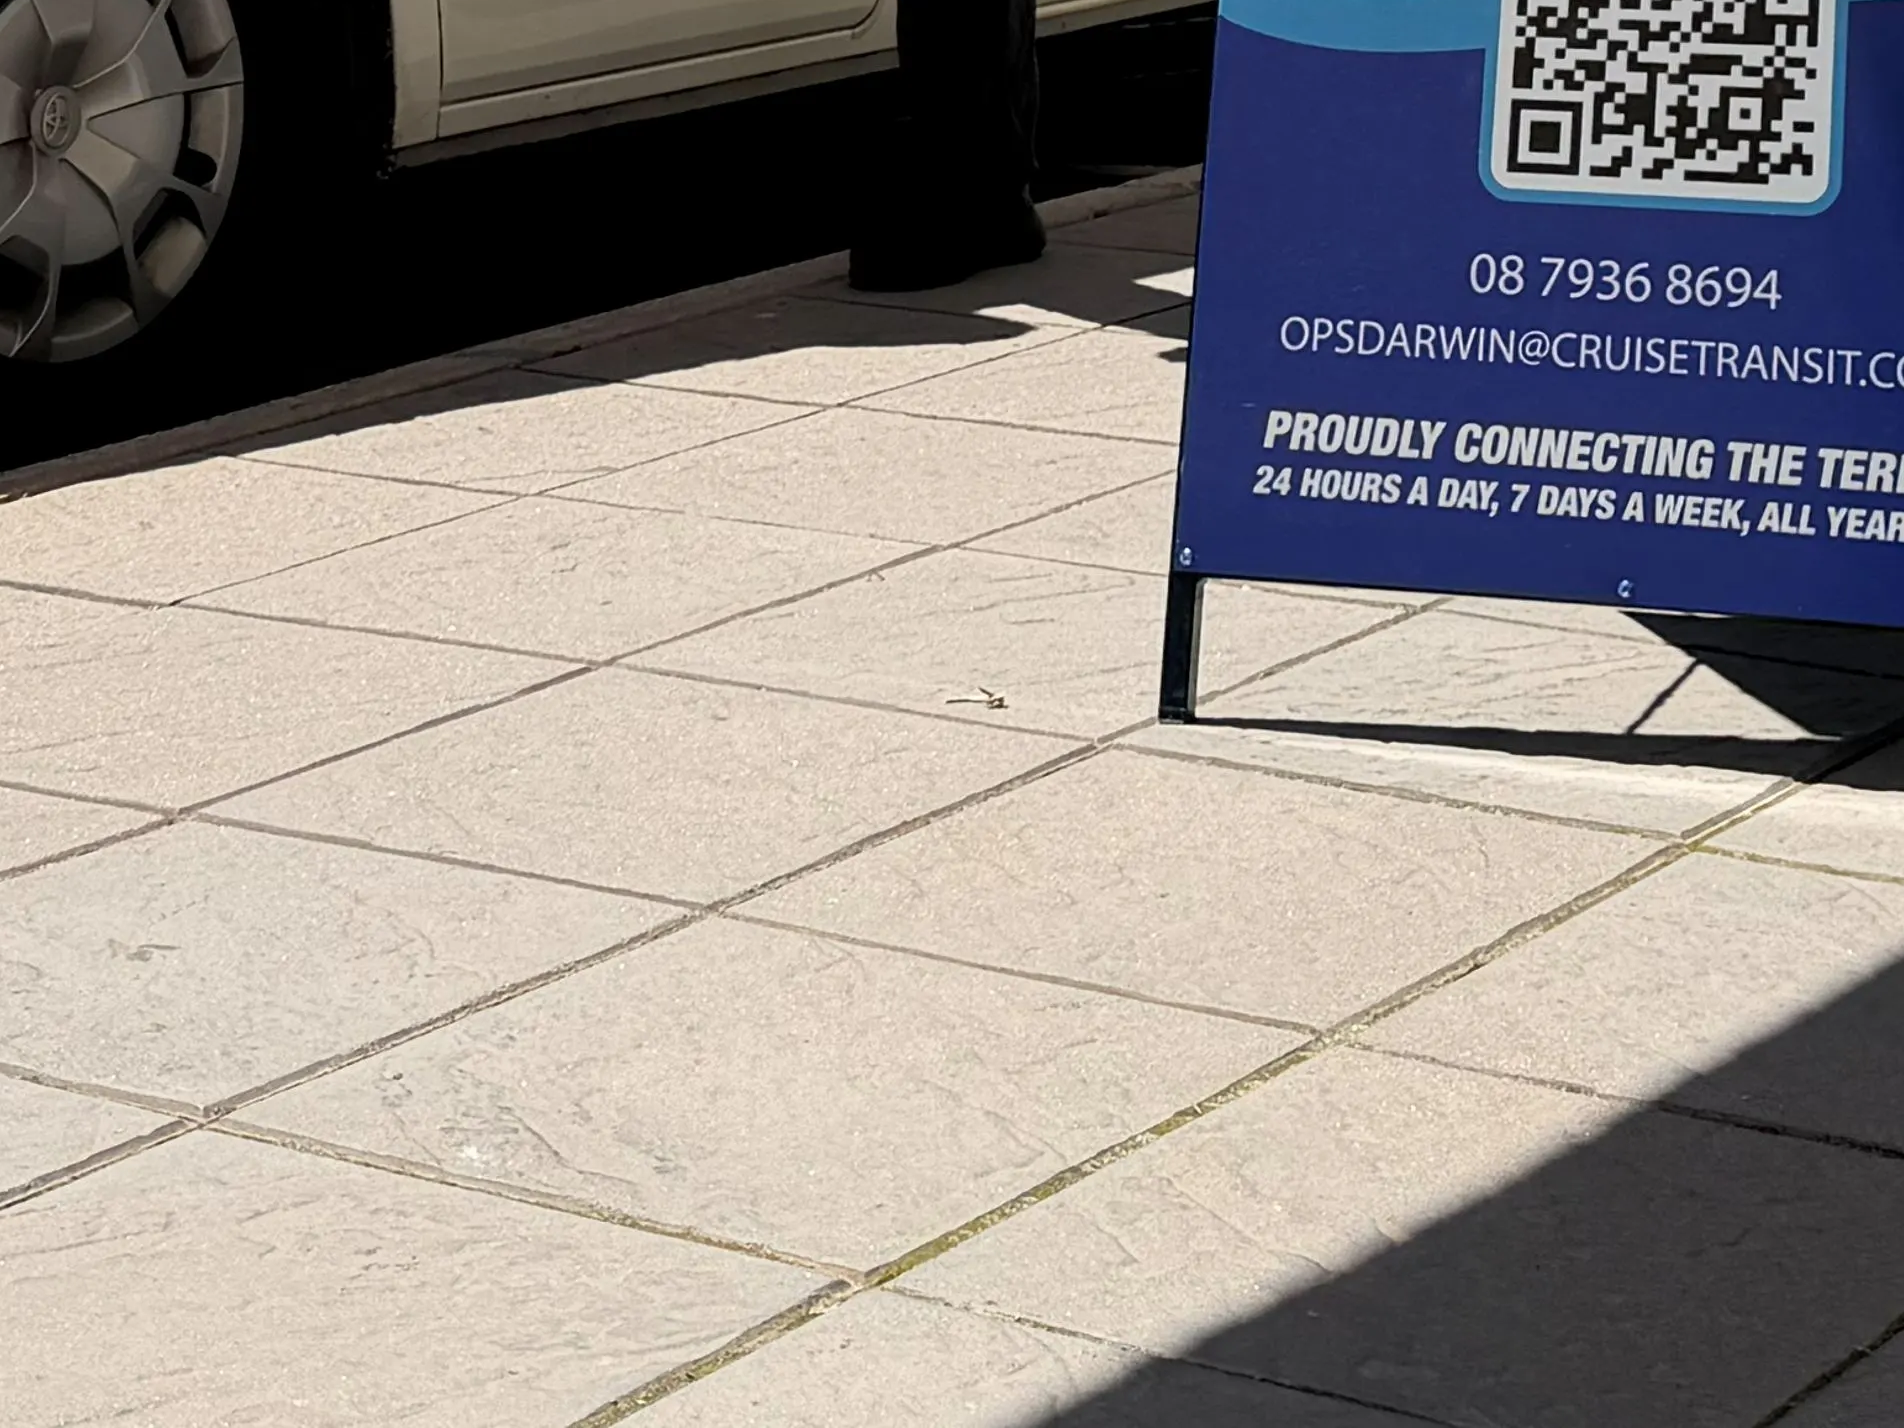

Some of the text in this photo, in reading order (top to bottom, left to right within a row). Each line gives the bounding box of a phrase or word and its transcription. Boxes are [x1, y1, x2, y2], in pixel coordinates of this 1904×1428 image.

[1470, 253, 1782, 311] 08 7936 8694
[1262, 409, 1448, 461] PROUDLY
[1453, 421, 1716, 480] CONNECTING
[1727, 441, 1808, 486] THE
[1252, 465, 1293, 497] 24
[1299, 467, 1402, 504] HOURS
[1406, 476, 1429, 506] A
[1437, 477, 1499, 518] DAY,
[1510, 483, 1532, 513] 7
[1536, 485, 1617, 520] DAYS
[1622, 491, 1645, 523] A
[1654, 493, 1750, 537] WEEK,
[1757, 501, 1817, 536] ALL
